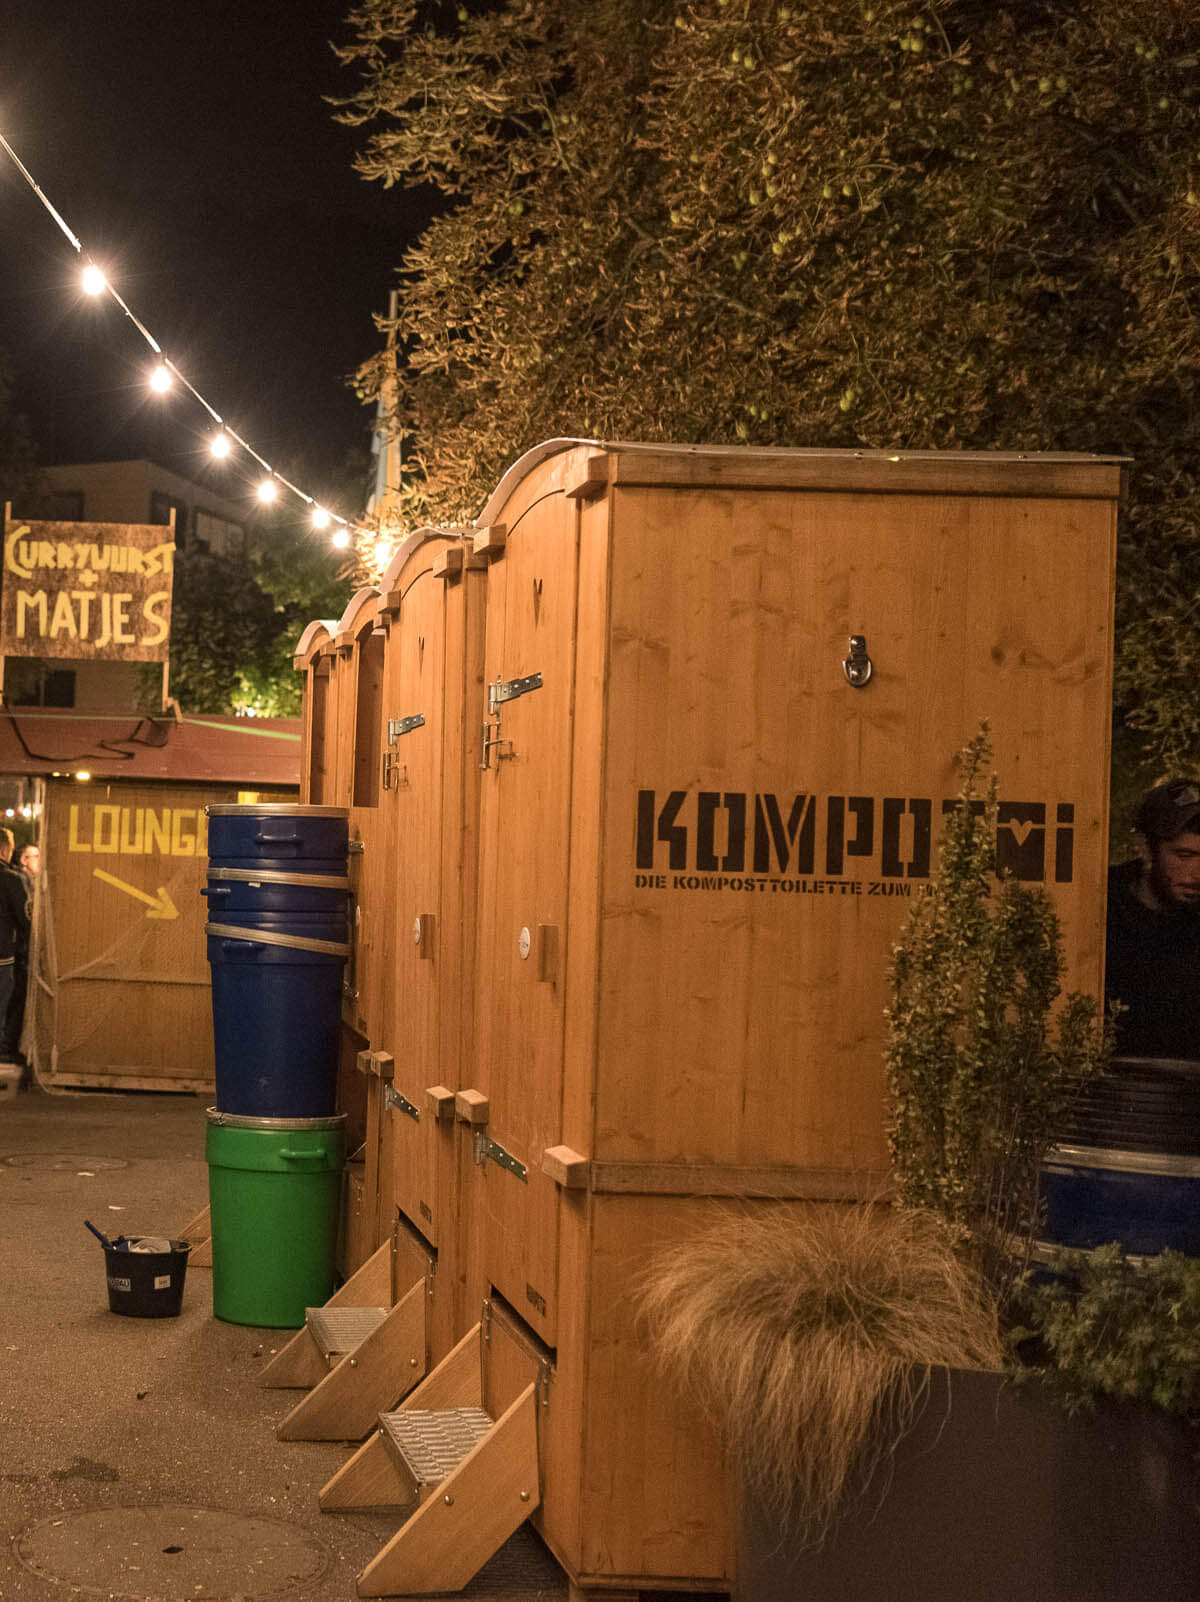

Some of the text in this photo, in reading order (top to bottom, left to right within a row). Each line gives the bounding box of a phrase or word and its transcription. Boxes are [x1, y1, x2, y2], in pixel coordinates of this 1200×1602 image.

[16, 589, 171, 648] MATJES
[635, 874, 667, 889] DIE
[672, 875, 863, 896] KOMPOSTTOILETTE
[867, 882, 911, 897] ZUM
